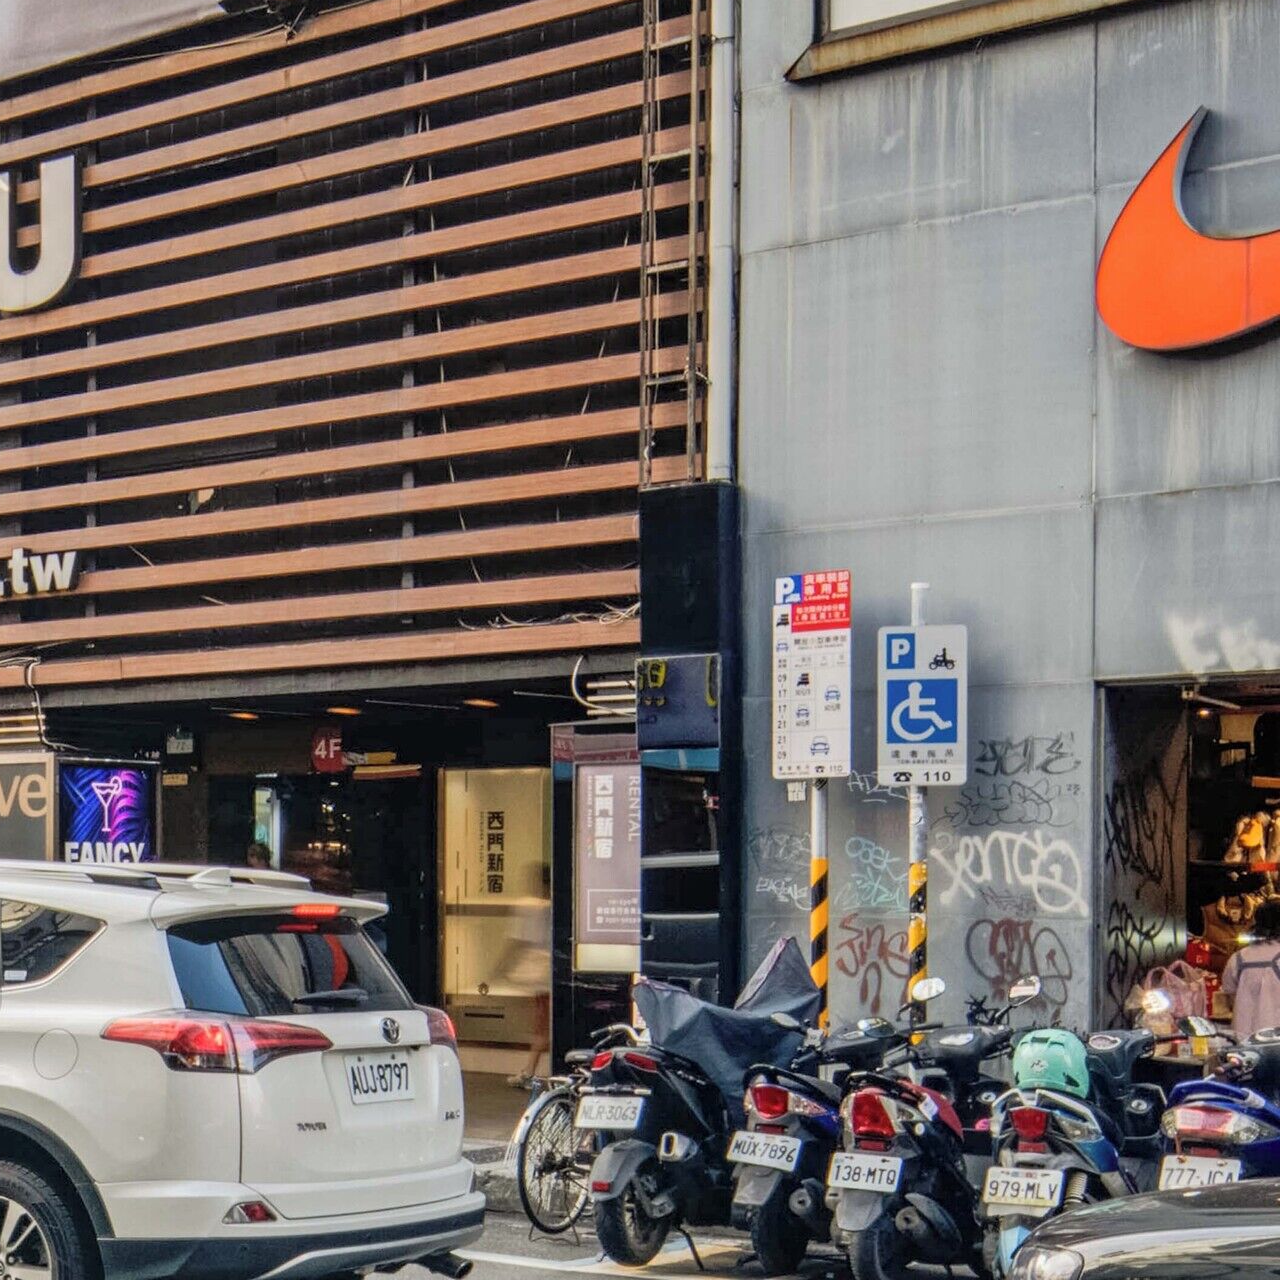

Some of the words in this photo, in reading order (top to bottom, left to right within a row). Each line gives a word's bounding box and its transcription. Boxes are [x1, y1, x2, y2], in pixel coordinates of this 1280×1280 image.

[891, 639, 910, 664] P
[315, 738, 342, 759] 4F
[924, 771, 951, 782] 110
[628, 775, 640, 842] RENTAL
[64, 841, 146, 863] FANCY
[487, 811, 504, 893] 西門新宿
